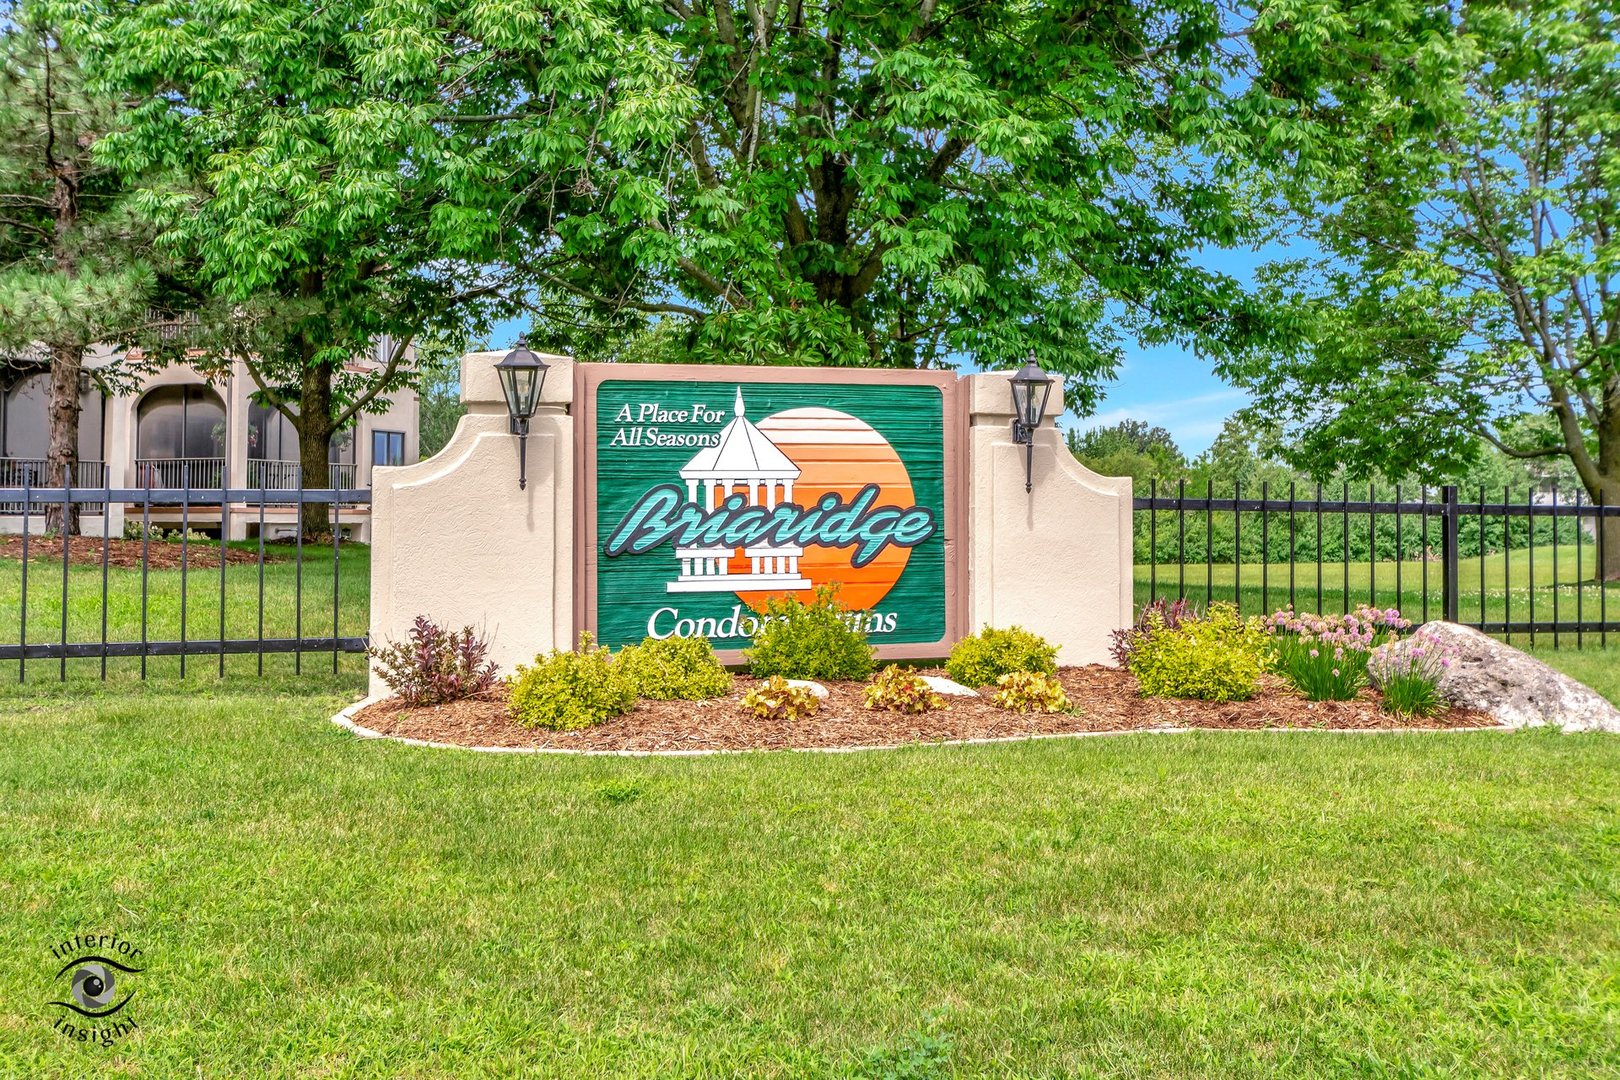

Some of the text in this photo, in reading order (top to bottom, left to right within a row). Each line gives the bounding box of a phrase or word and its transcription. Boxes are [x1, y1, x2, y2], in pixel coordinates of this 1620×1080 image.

[614, 403, 726, 423] A Place For
[609, 427, 721, 448] All Seasons
[605, 484, 936, 567] Briaridge
